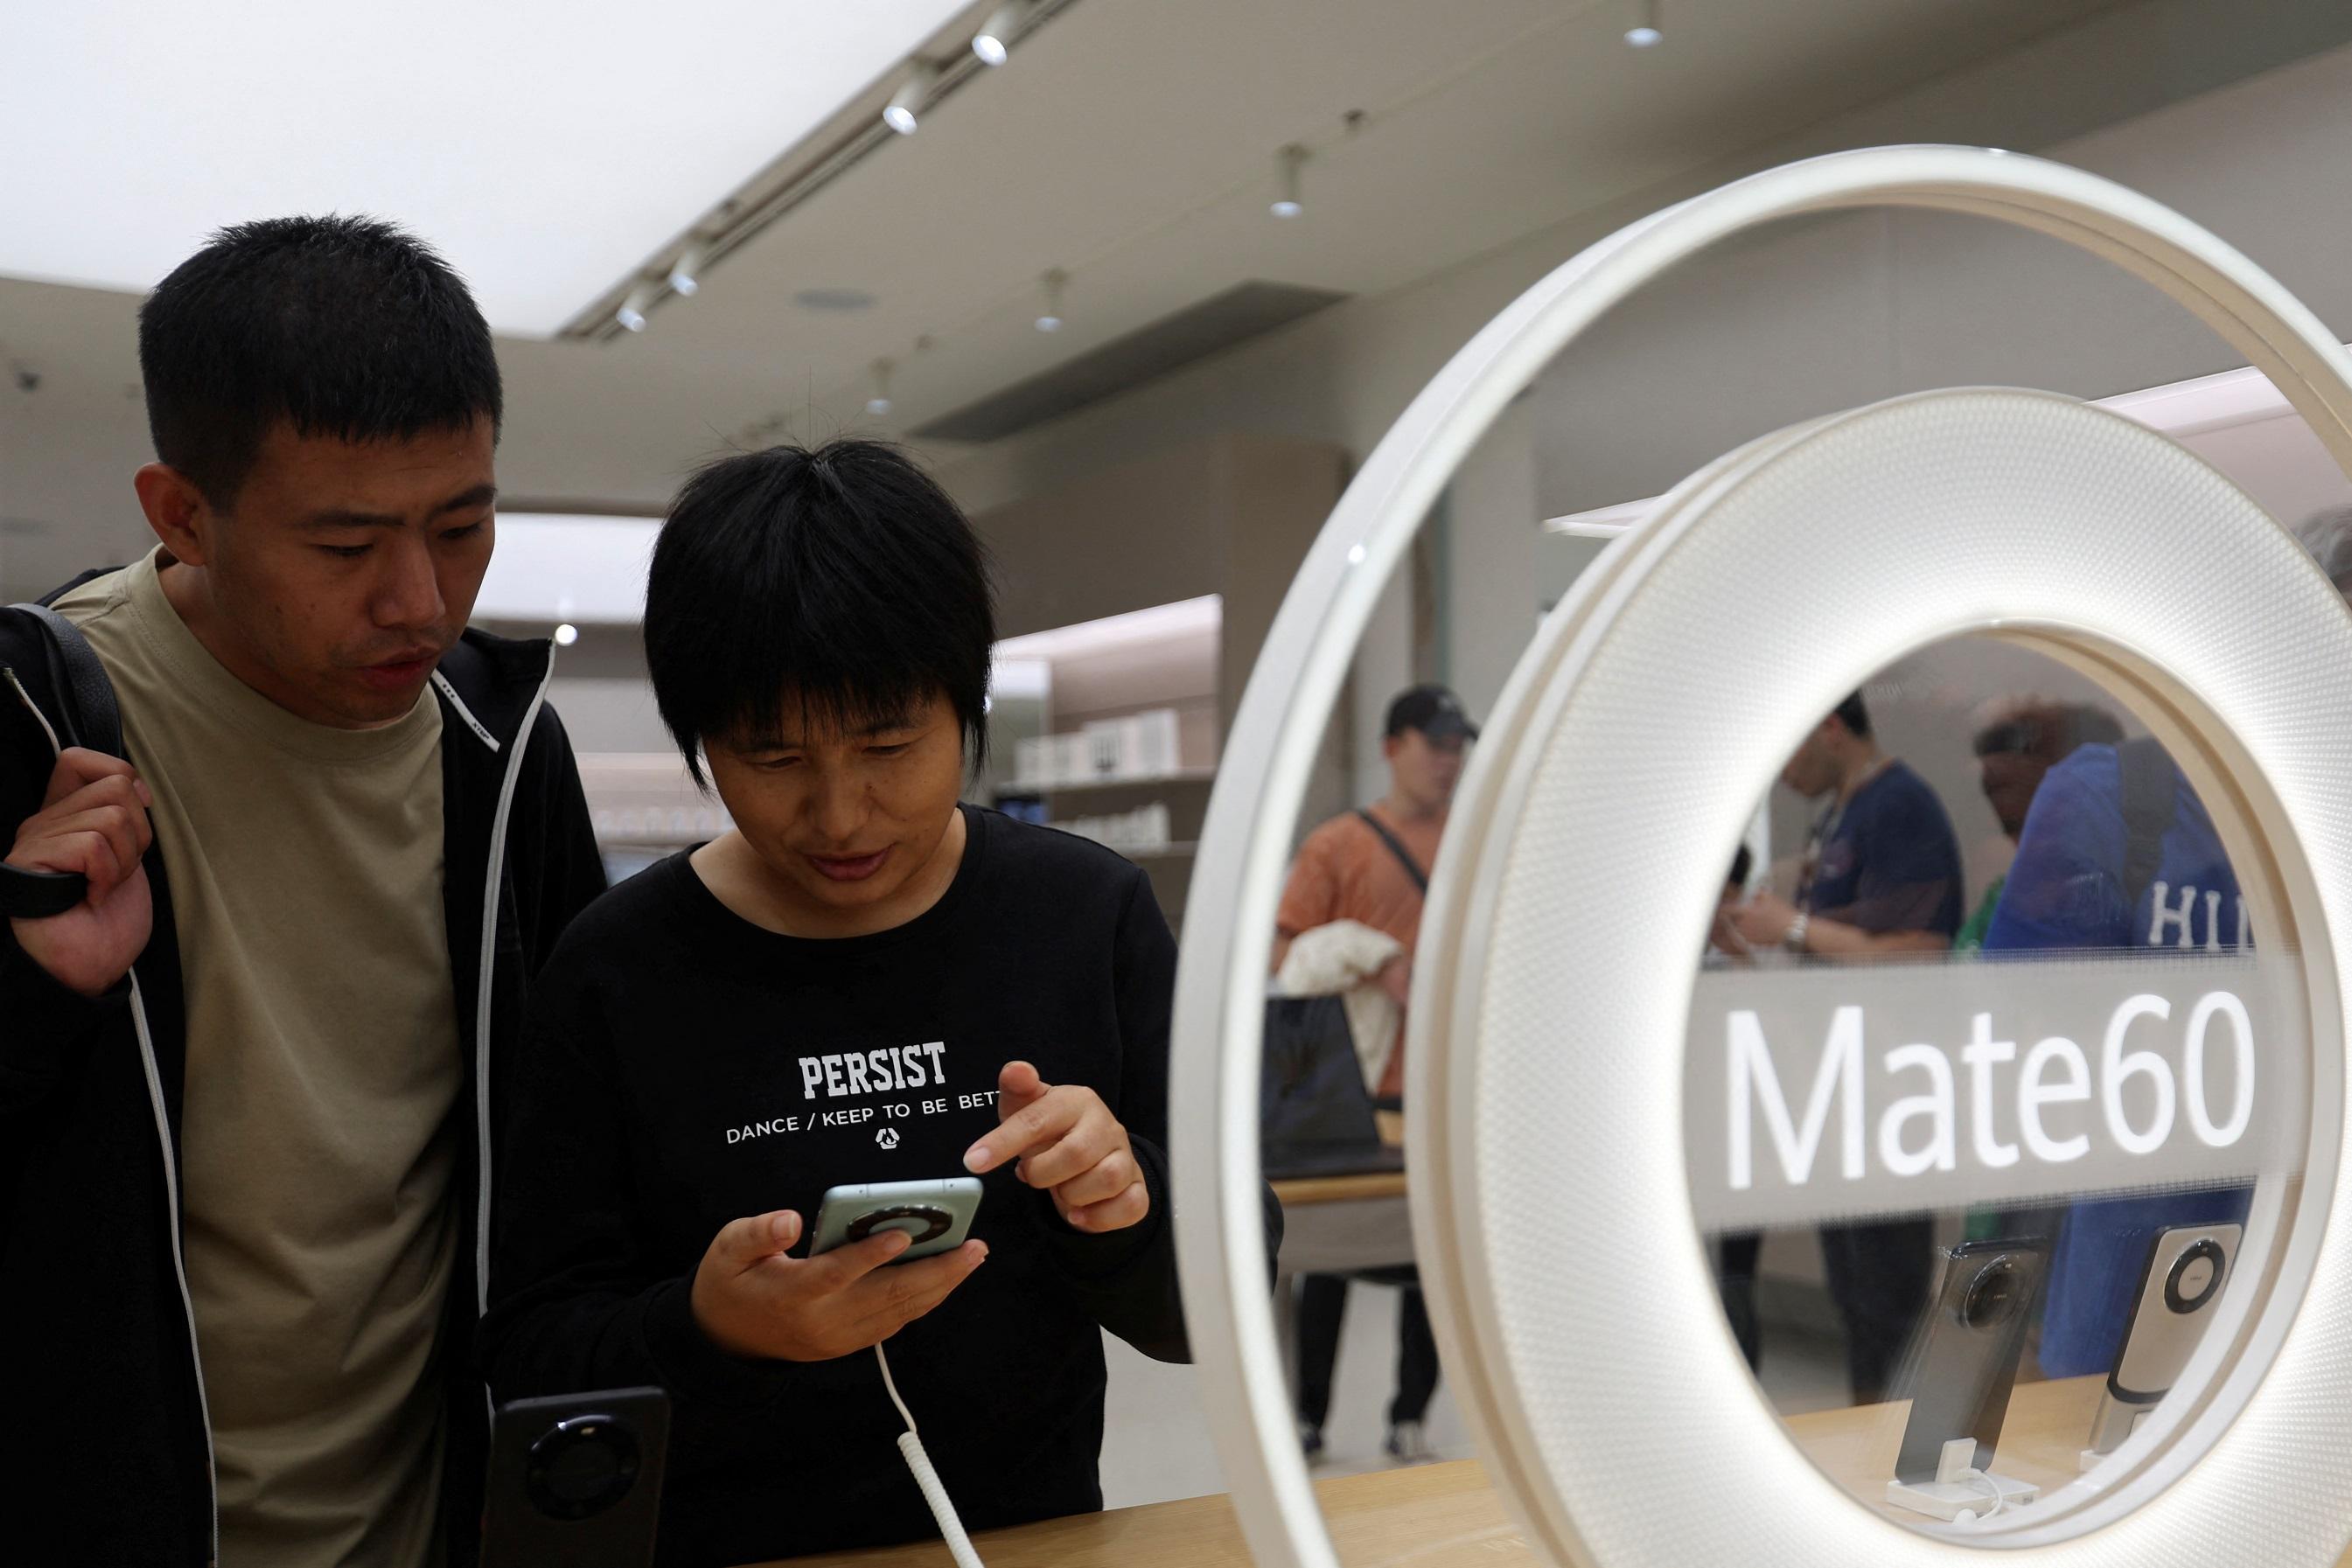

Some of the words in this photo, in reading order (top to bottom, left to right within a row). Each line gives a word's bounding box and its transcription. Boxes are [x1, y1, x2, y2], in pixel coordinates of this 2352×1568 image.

[799, 1042, 946, 1099] PERSIST
[1727, 991, 2256, 1189] Mate60
[727, 1116, 799, 1144] DANCE
[806, 1112, 816, 1131] /
[822, 1107, 874, 1126] KEEP
[883, 1104, 911, 1119] TO
[923, 1098, 948, 1115] BE
